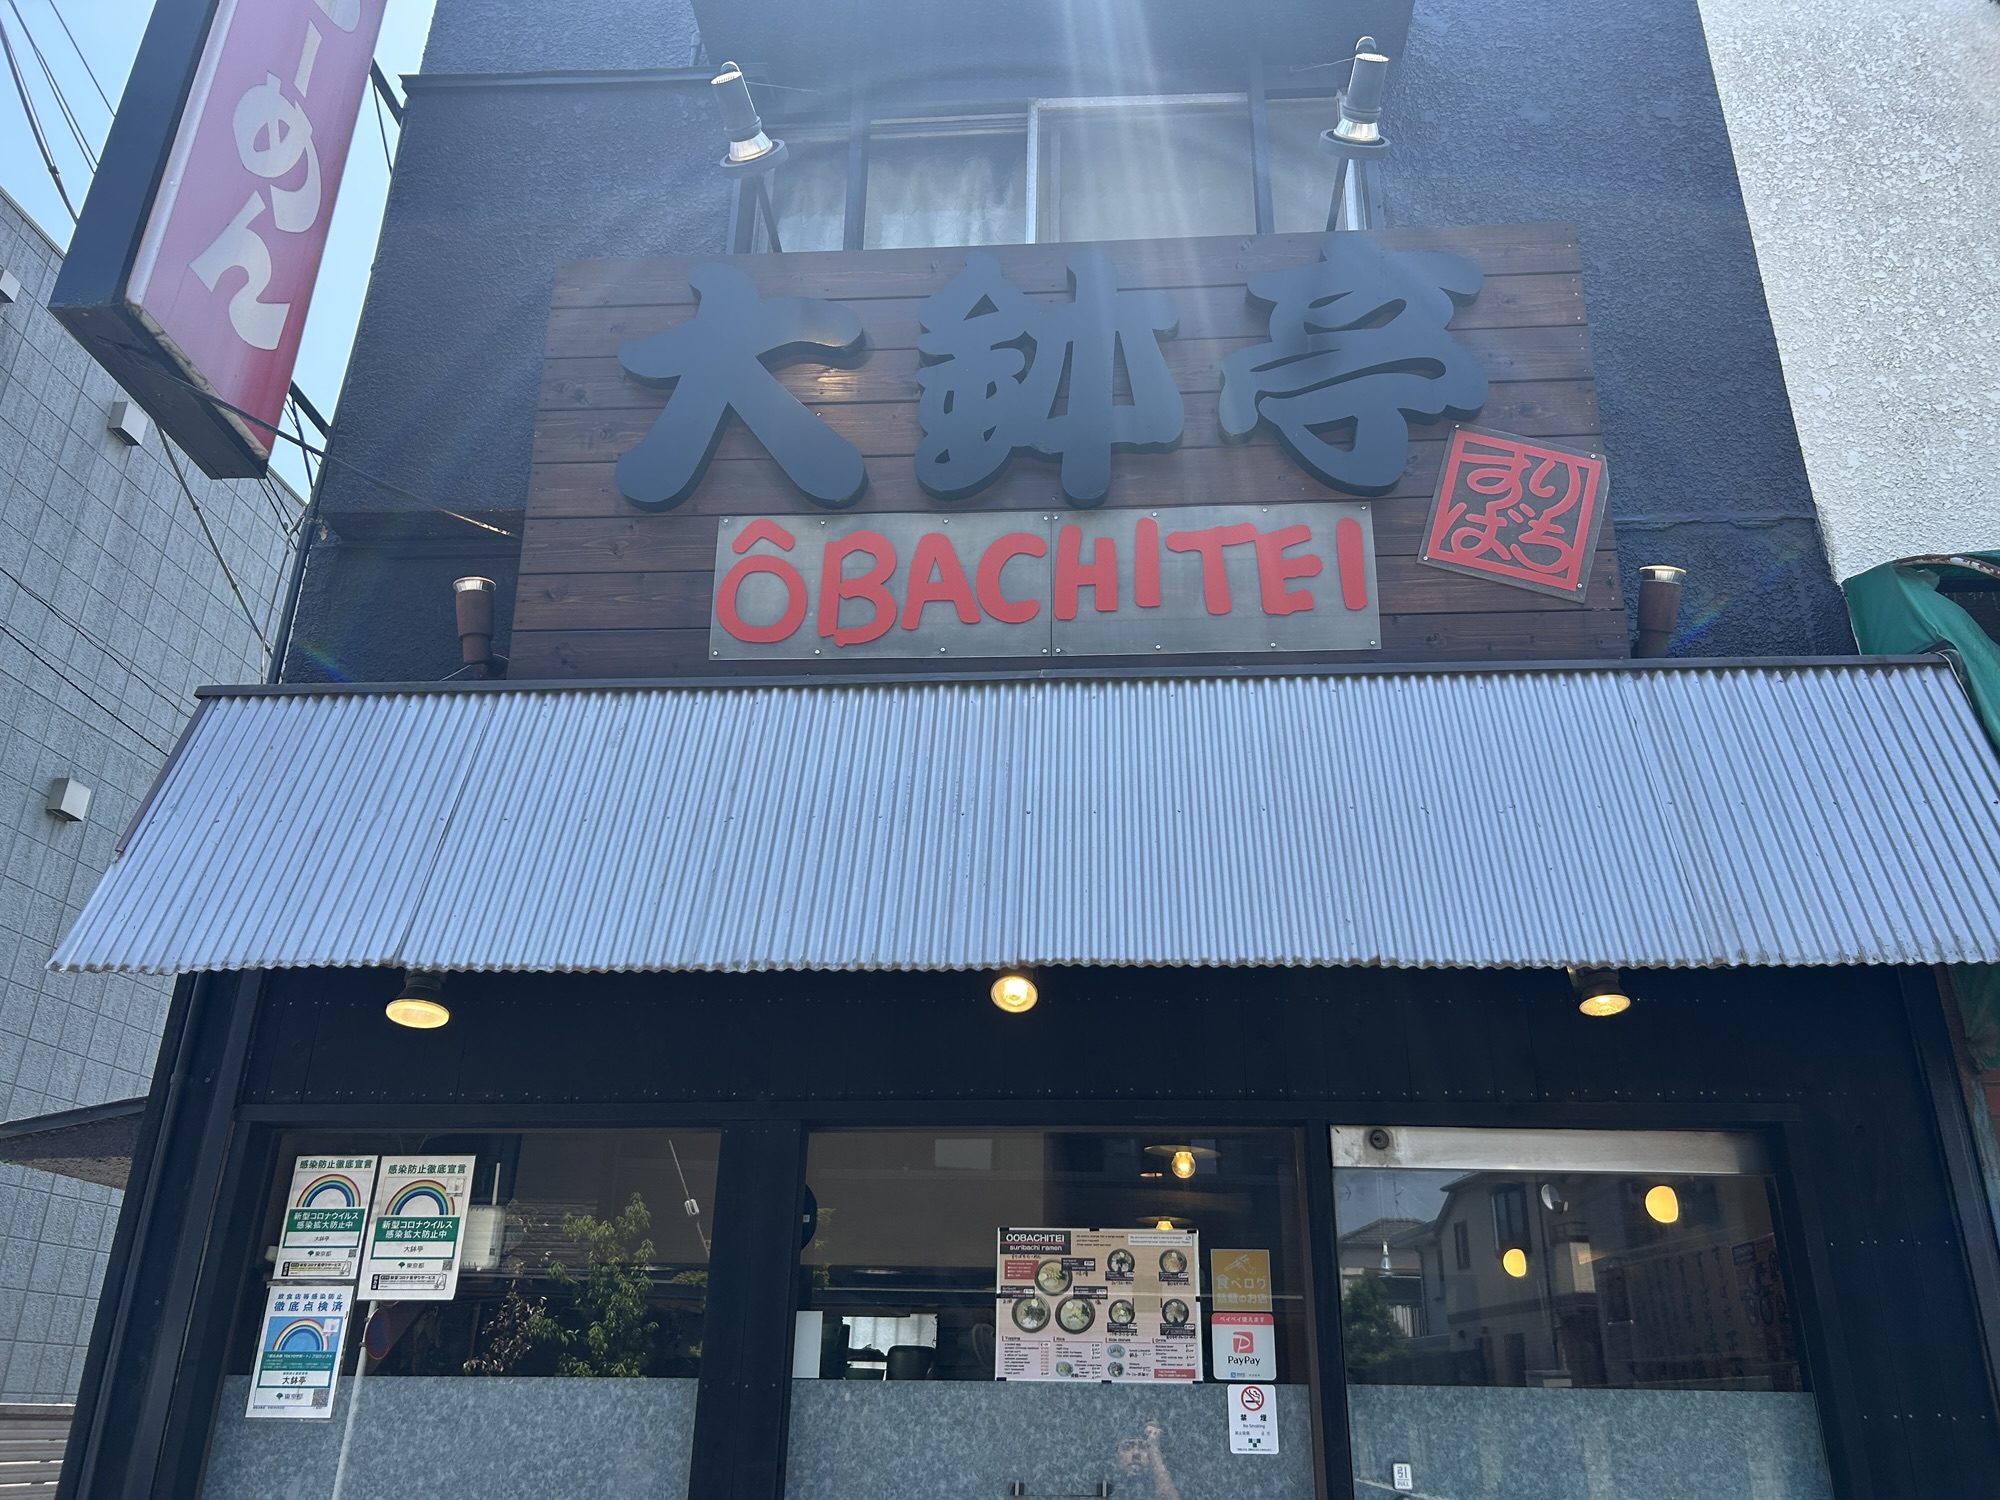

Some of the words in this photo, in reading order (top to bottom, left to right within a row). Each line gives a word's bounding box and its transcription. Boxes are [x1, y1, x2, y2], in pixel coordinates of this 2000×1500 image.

[615, 236, 1490, 510] 大鉢亭
[299, 1159, 373, 1169] 感染防止徹底宣言
[387, 1164, 467, 1174] 感染防止徹底宣言
[293, 1212, 359, 1221] 新型コロナウイルス
[296, 1221, 353, 1229] 感染拡大防止中
[382, 1220, 453, 1229] 新型コロナウイルス
[385, 1230, 448, 1239] 感染拡大防止中
[1006, 1233, 1065, 1243] OOBACHITEI
[1215, 1274, 1267, 1289] 食べログ
[274, 1301, 344, 1312] 徹底点検済
[1227, 1355, 1261, 1366] PayPay
[282, 1376, 307, 1385] 大鉢亭
